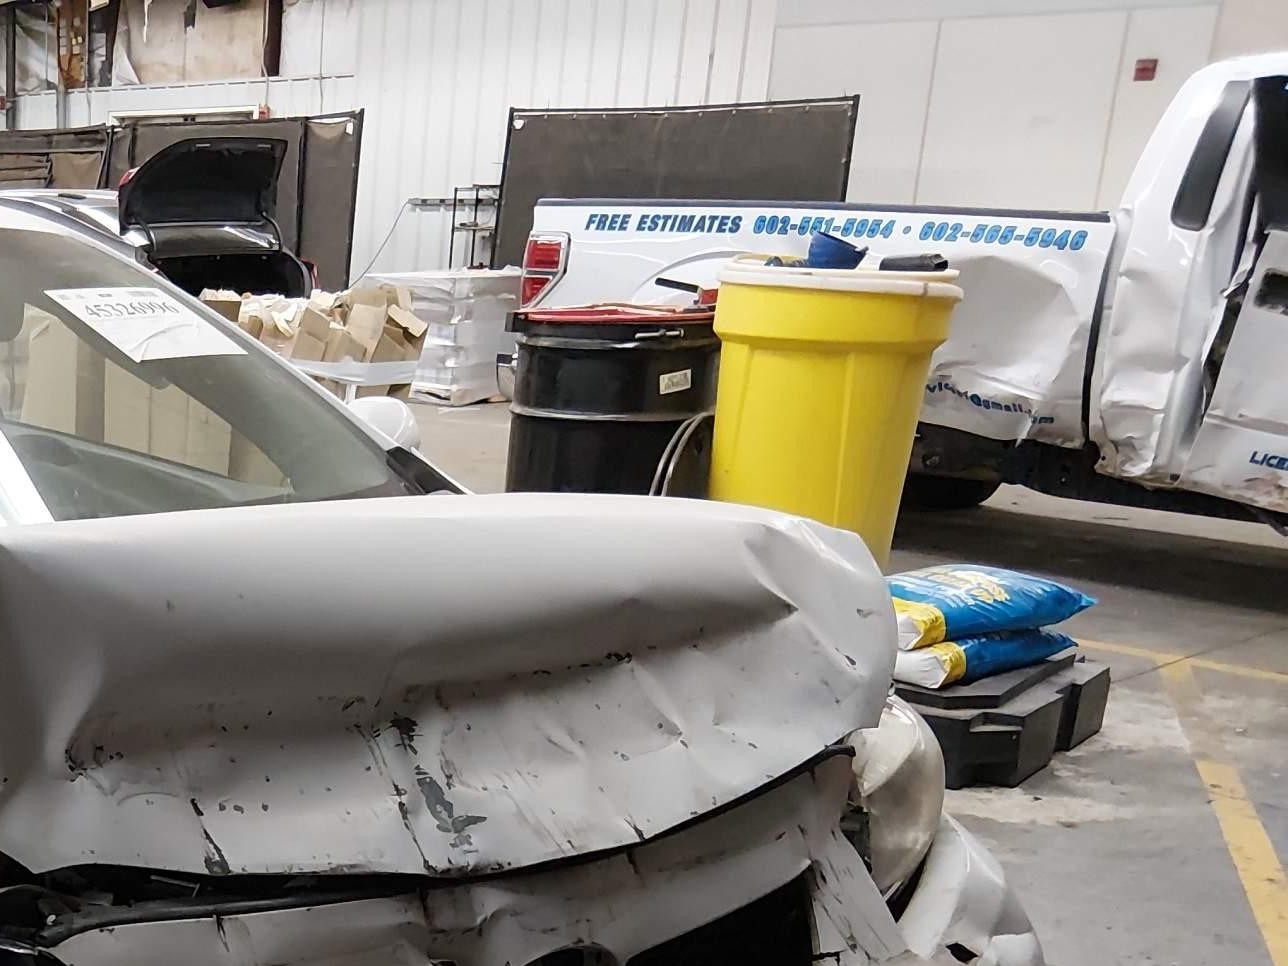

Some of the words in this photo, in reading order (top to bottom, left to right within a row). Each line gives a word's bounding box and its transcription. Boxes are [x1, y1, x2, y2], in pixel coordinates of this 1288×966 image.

[584, 213, 632, 231] FREE
[636, 214, 743, 233] ESTIMATES
[752, 215, 896, 239] 602-551-5954
[919, 221, 1088, 250] 602-565-5946
[85, 301, 180, 319] 45326996
